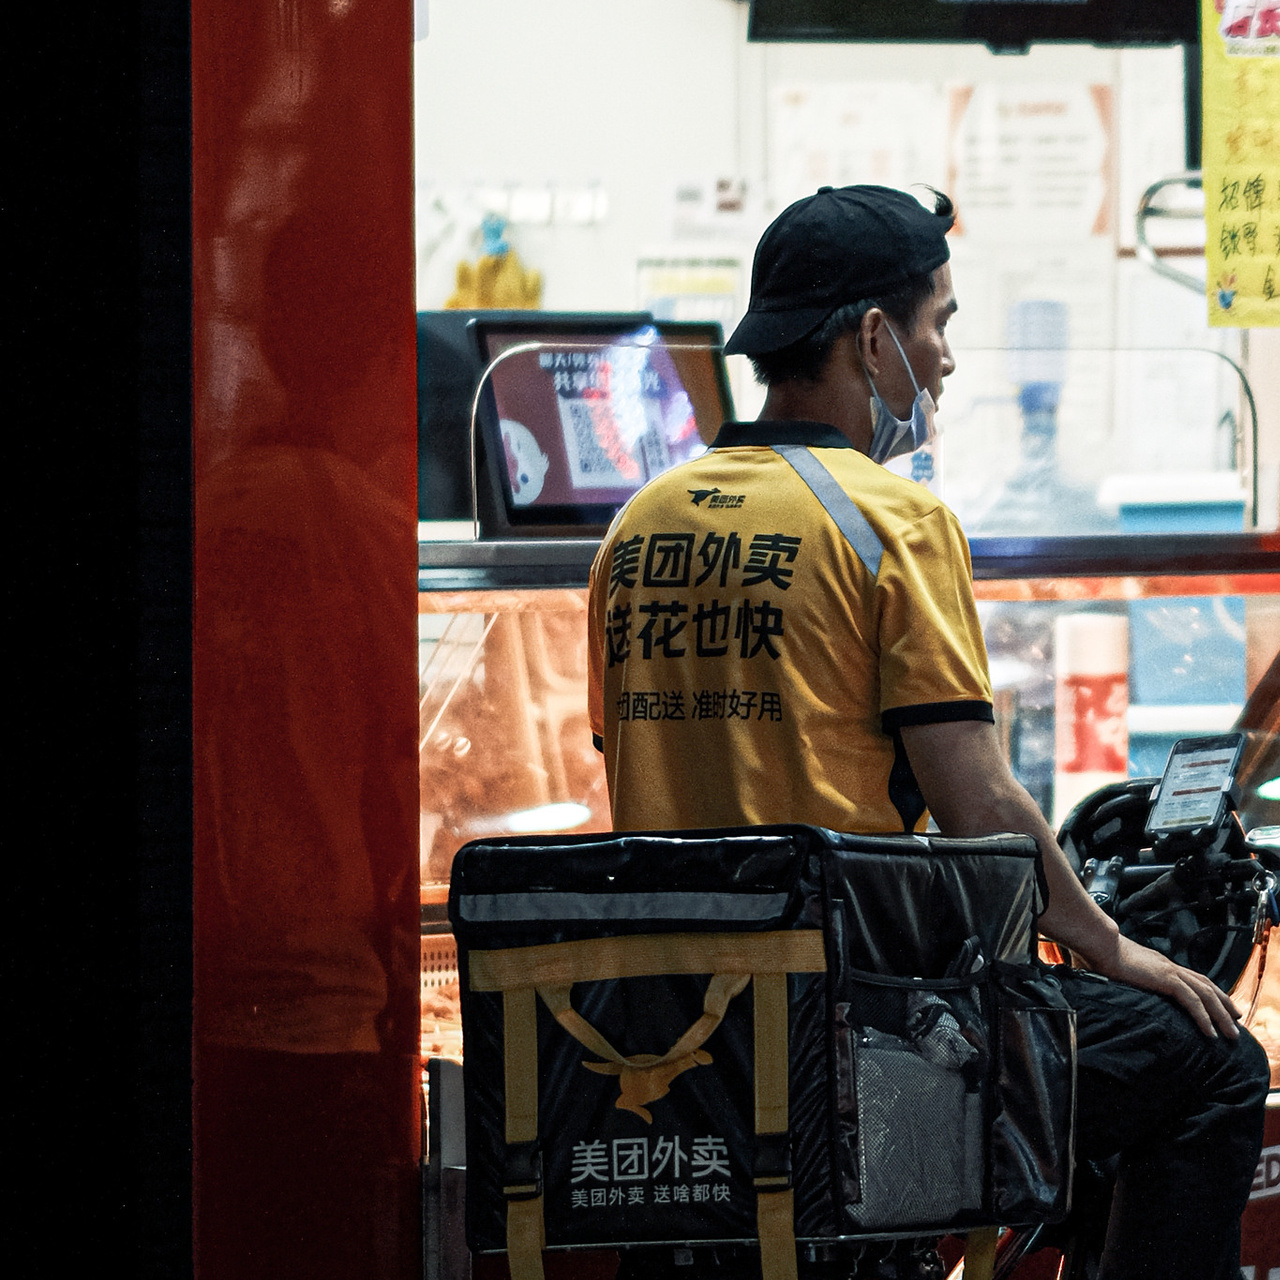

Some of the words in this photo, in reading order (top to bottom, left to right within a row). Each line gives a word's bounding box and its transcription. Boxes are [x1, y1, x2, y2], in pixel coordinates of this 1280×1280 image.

[609, 532, 802, 596] 美团外卖
[691, 689, 782, 721] 准时好用
[571, 1135, 731, 1183] 美团外卖
[571, 1186, 645, 1208] 美团外卖
[654, 1183, 731, 1203] 送啥都快
